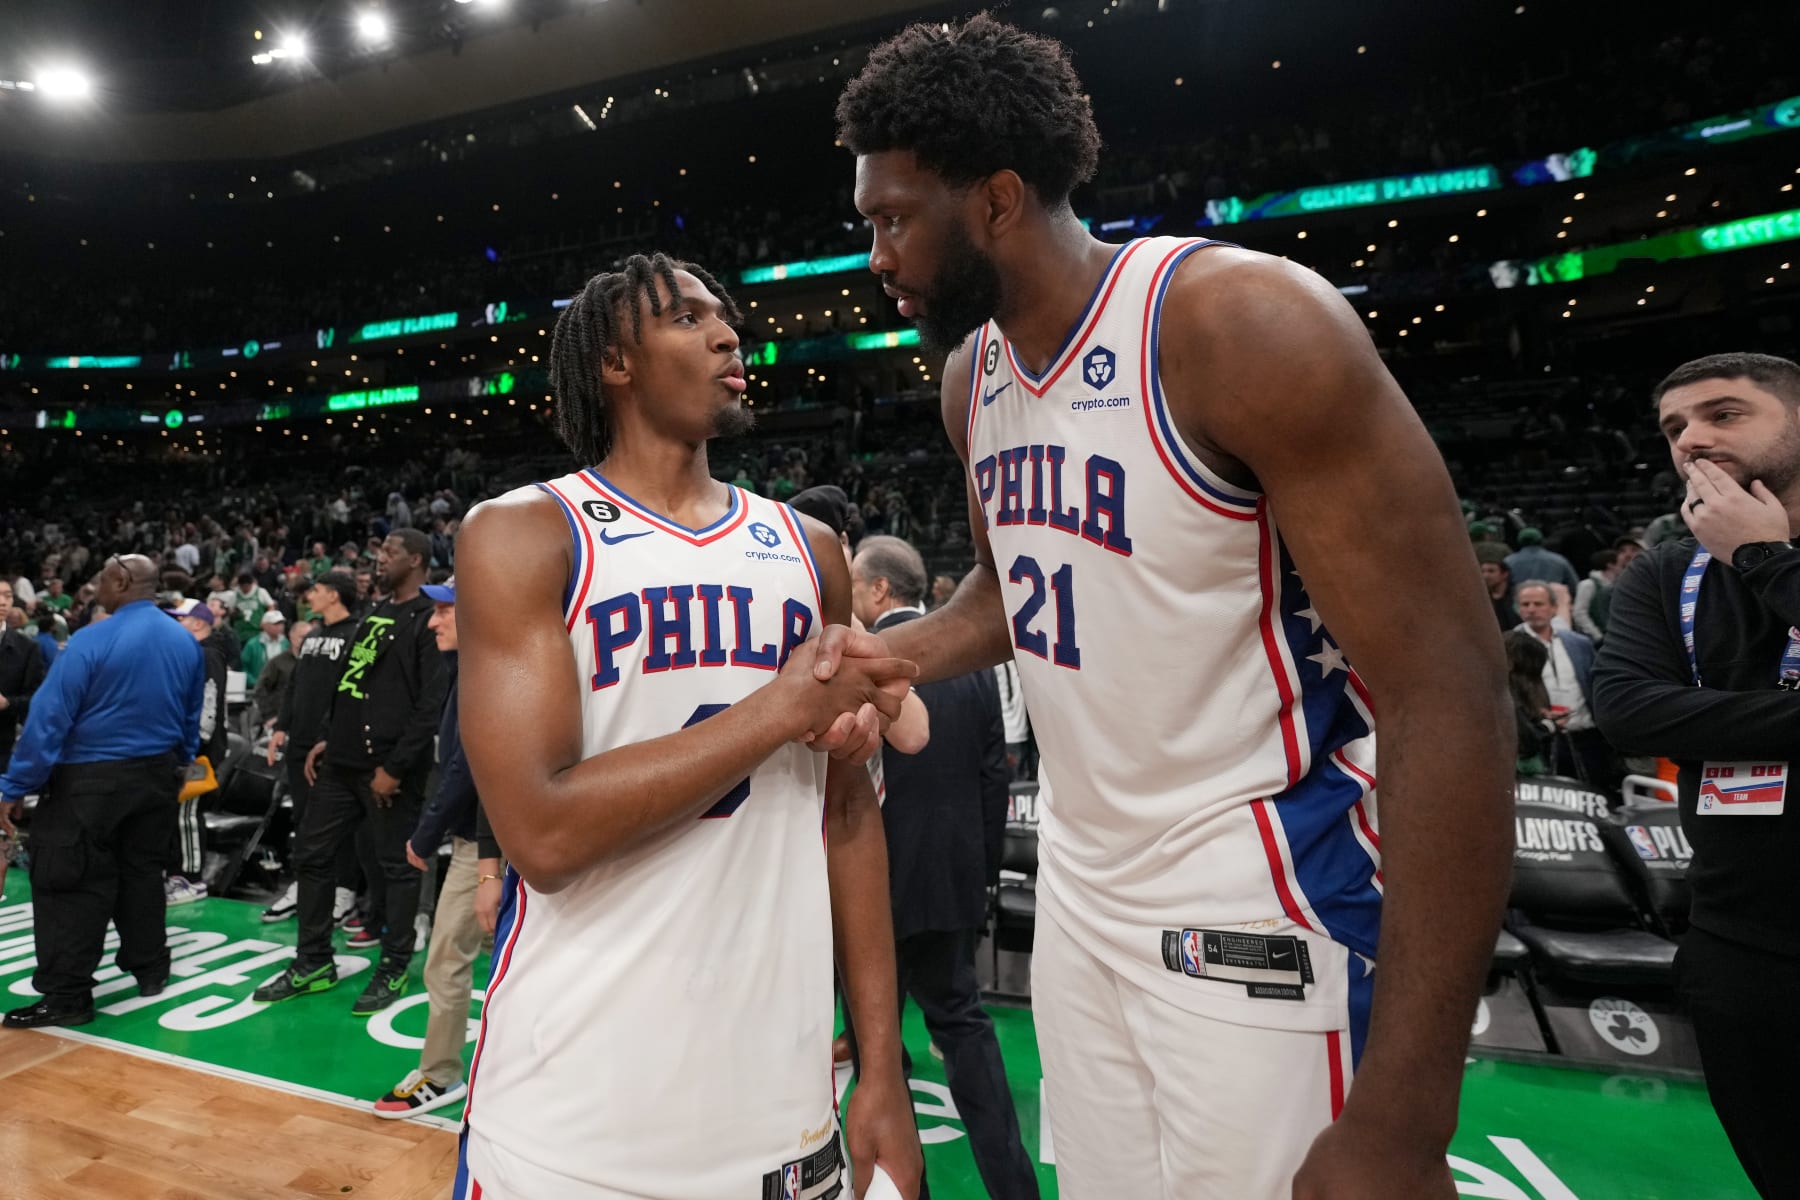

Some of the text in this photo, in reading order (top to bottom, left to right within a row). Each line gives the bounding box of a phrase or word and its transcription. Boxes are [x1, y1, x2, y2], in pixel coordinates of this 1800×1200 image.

[1701, 211, 1800, 249] CELTIC
[1071, 395, 1130, 411] crypto.com
[590, 503, 613, 519] 6
[975, 445, 1133, 557] PHILA
[745, 550, 801, 564] crypto.com
[1009, 555, 1080, 670] 21
[585, 584, 813, 692] PHILA
[1516, 817, 1605, 852] LAYOFFS
[1207, 944, 1218, 953] 54
